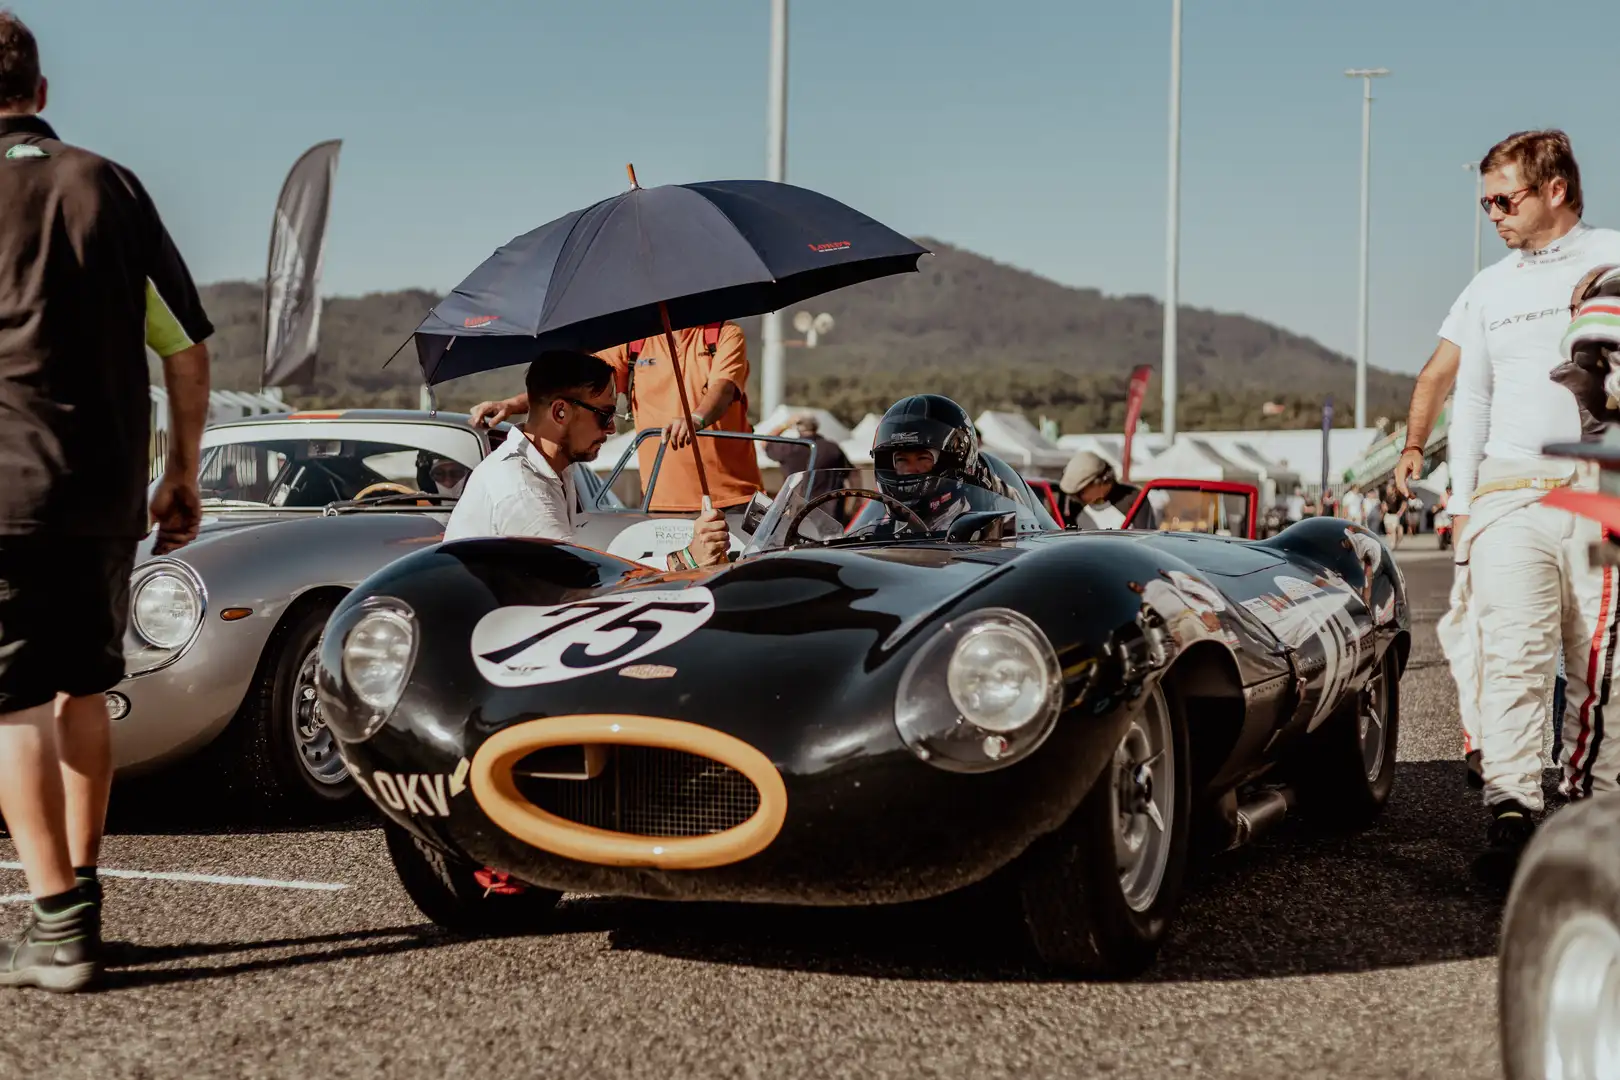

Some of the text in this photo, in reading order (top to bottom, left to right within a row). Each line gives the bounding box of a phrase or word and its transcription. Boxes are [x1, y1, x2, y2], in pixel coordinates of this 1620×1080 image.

[1489, 307, 1570, 331] CATERH
[654, 532, 694, 540] RACIN
[478, 601, 710, 669] 75
[373, 770, 450, 817] OKV
